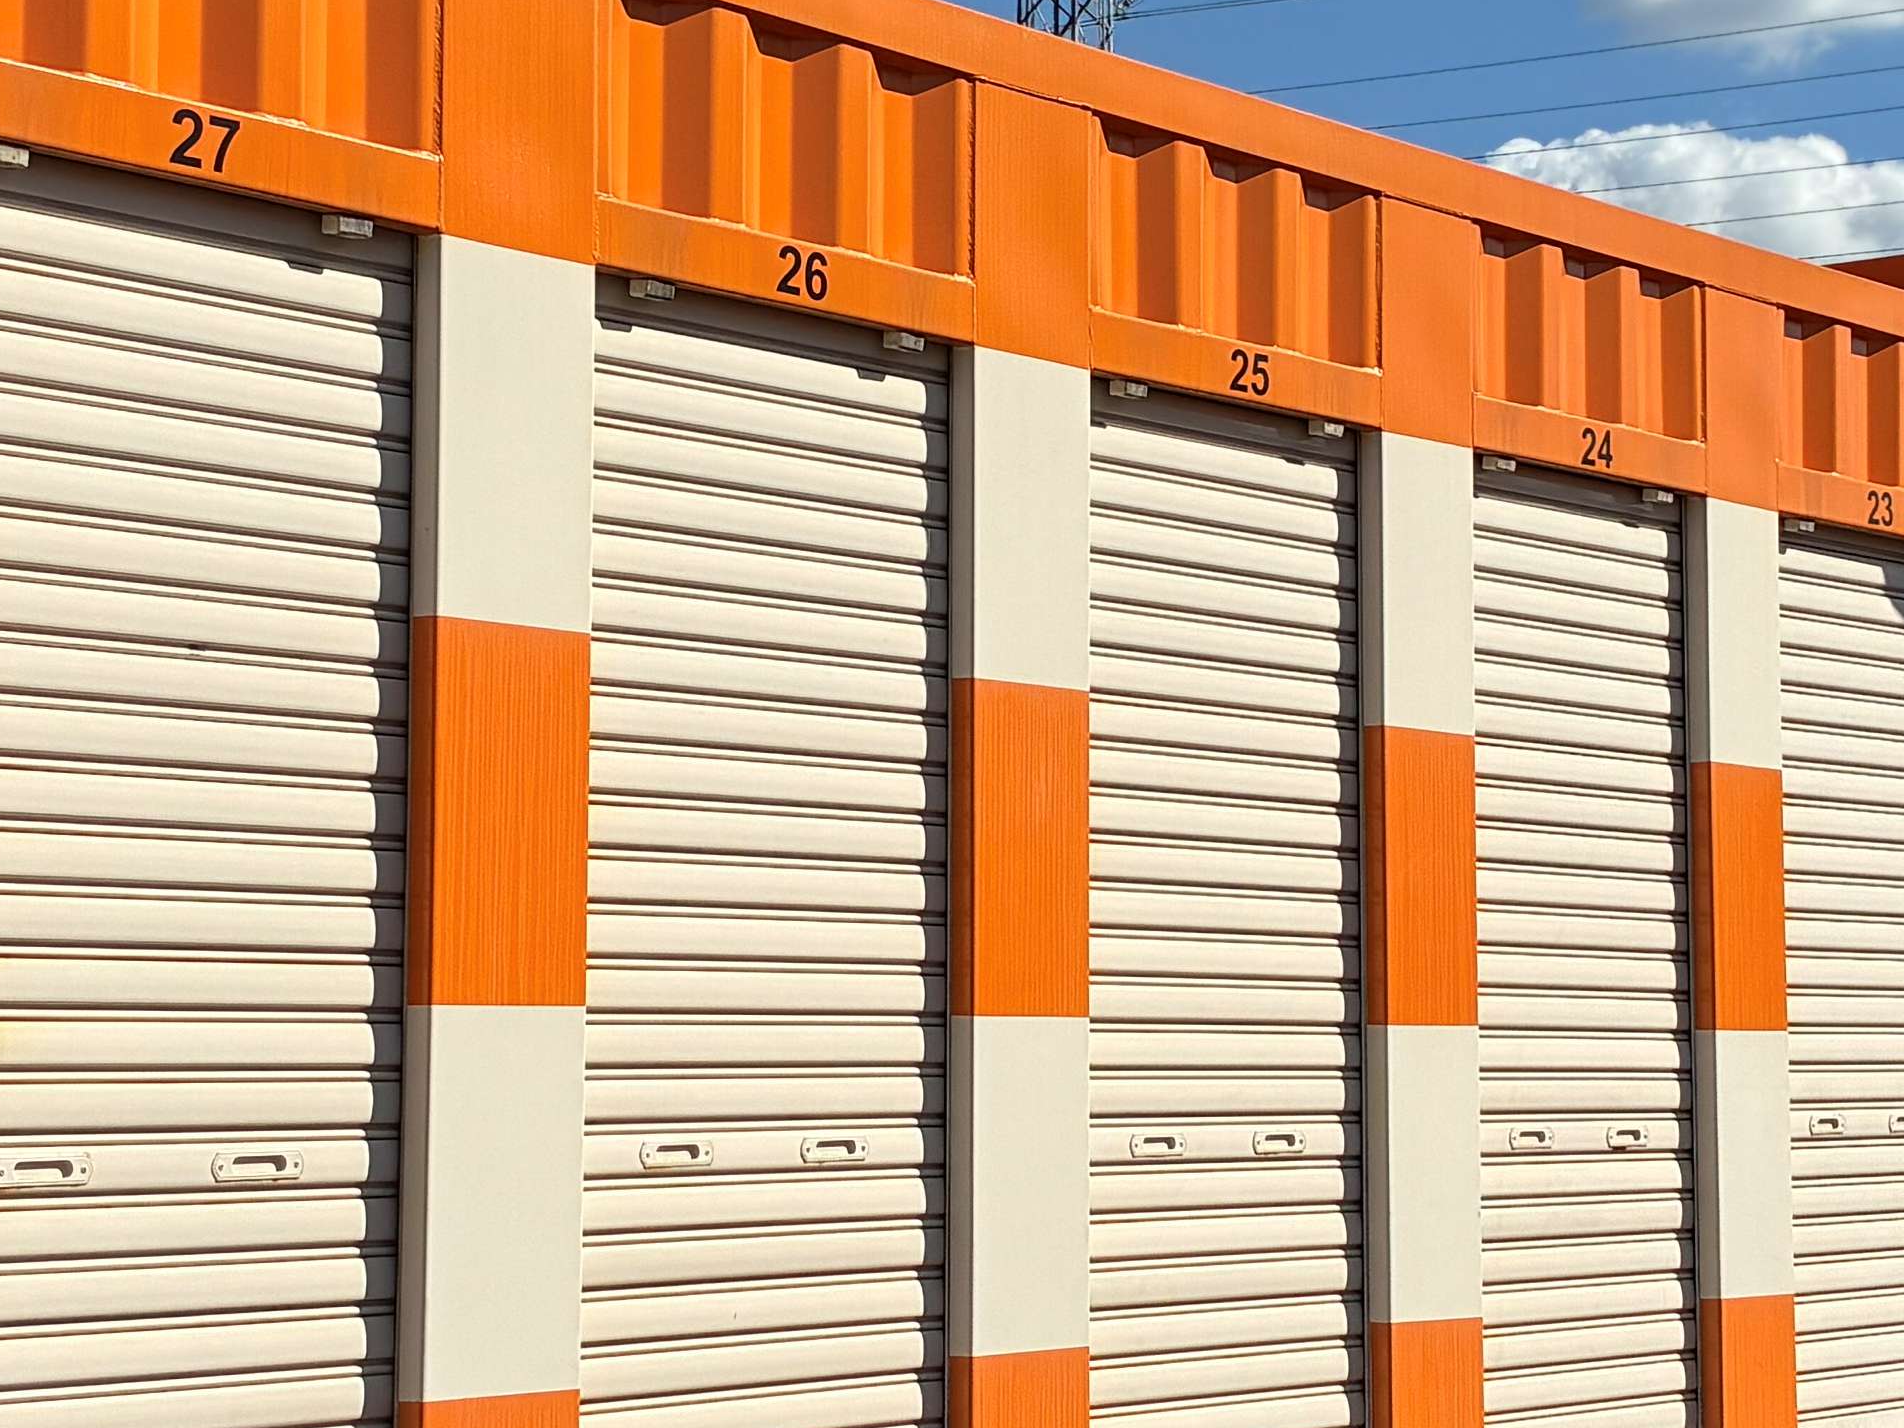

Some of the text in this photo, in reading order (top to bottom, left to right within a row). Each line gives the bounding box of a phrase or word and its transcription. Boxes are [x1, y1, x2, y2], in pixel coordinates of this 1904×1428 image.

[168, 108, 241, 174] 27
[776, 245, 829, 302] 26
[1229, 348, 1271, 397] 25
[1580, 426, 1614, 470] 24
[1866, 489, 1895, 528] 23
